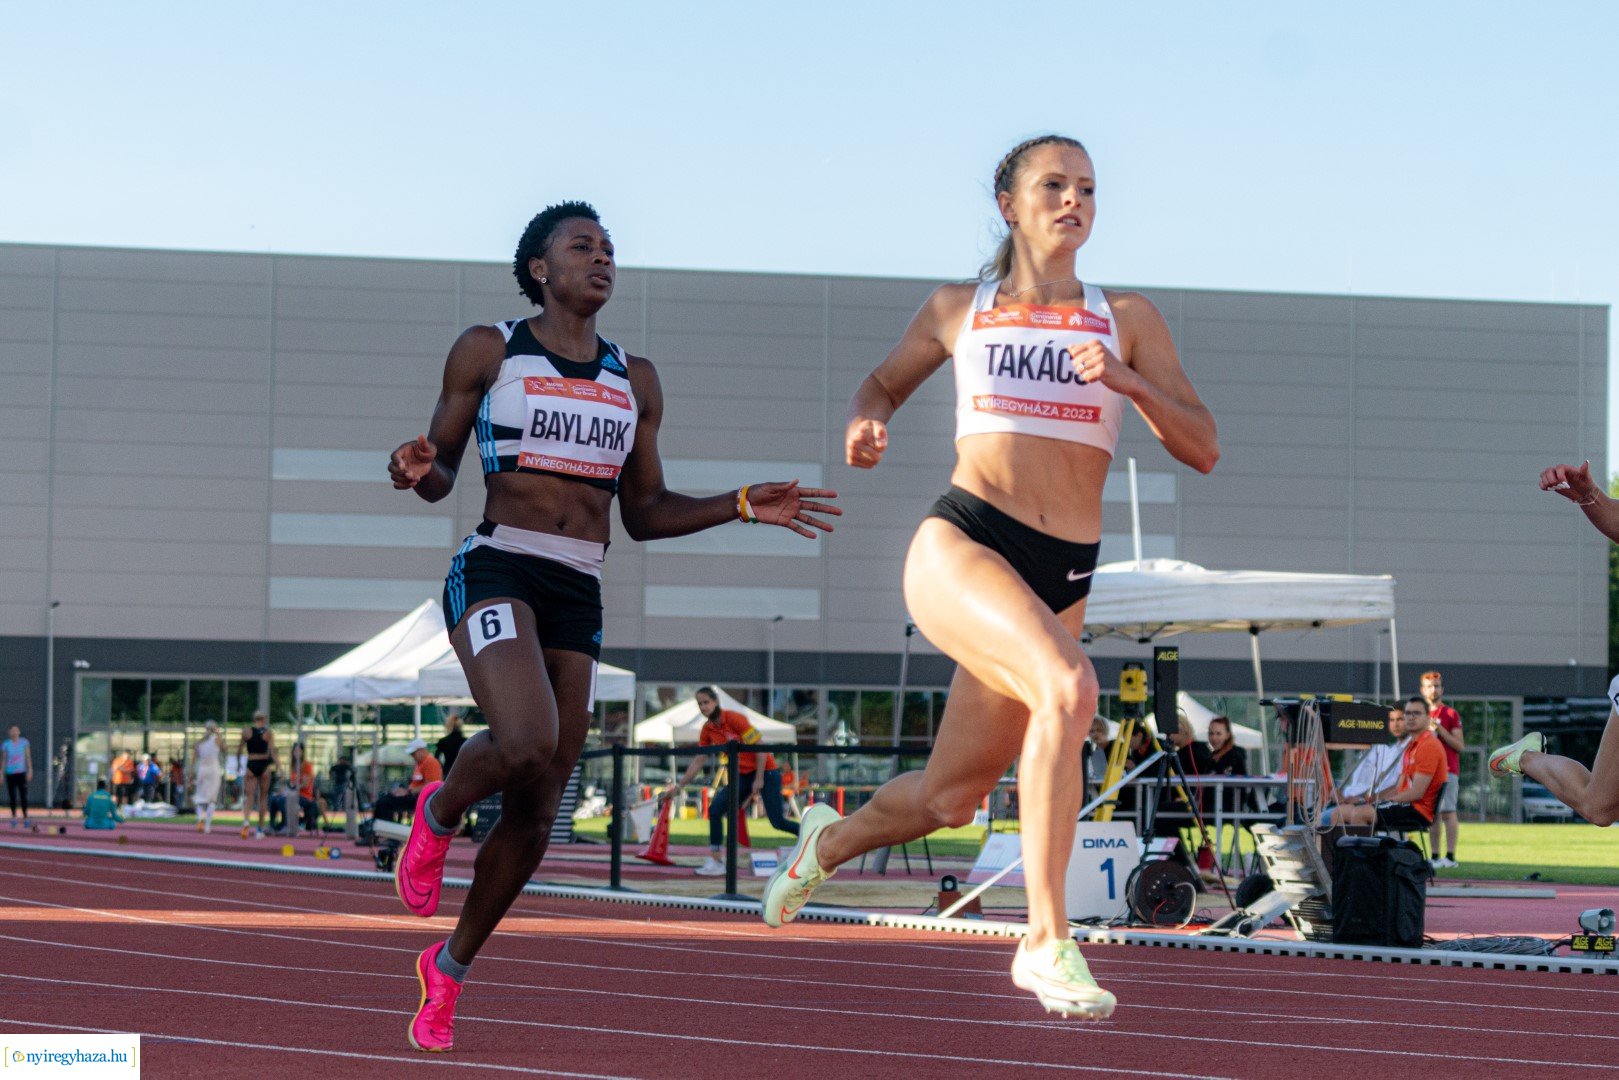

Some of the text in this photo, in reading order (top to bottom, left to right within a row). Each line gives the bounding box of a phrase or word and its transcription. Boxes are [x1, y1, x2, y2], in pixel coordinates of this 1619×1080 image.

[985, 340, 1089, 386] TAKÁC
[976, 396, 1094, 420] NYÍREGYHÁZA 2023
[530, 408, 631, 452] BAYLARK
[525, 455, 615, 476] NYÍREGYHÁZA 2023
[480, 609, 502, 641] 6
[1157, 651, 1179, 661] ALGE
[1082, 838, 1129, 848] DIMA
[1100, 858, 1116, 900] 1
